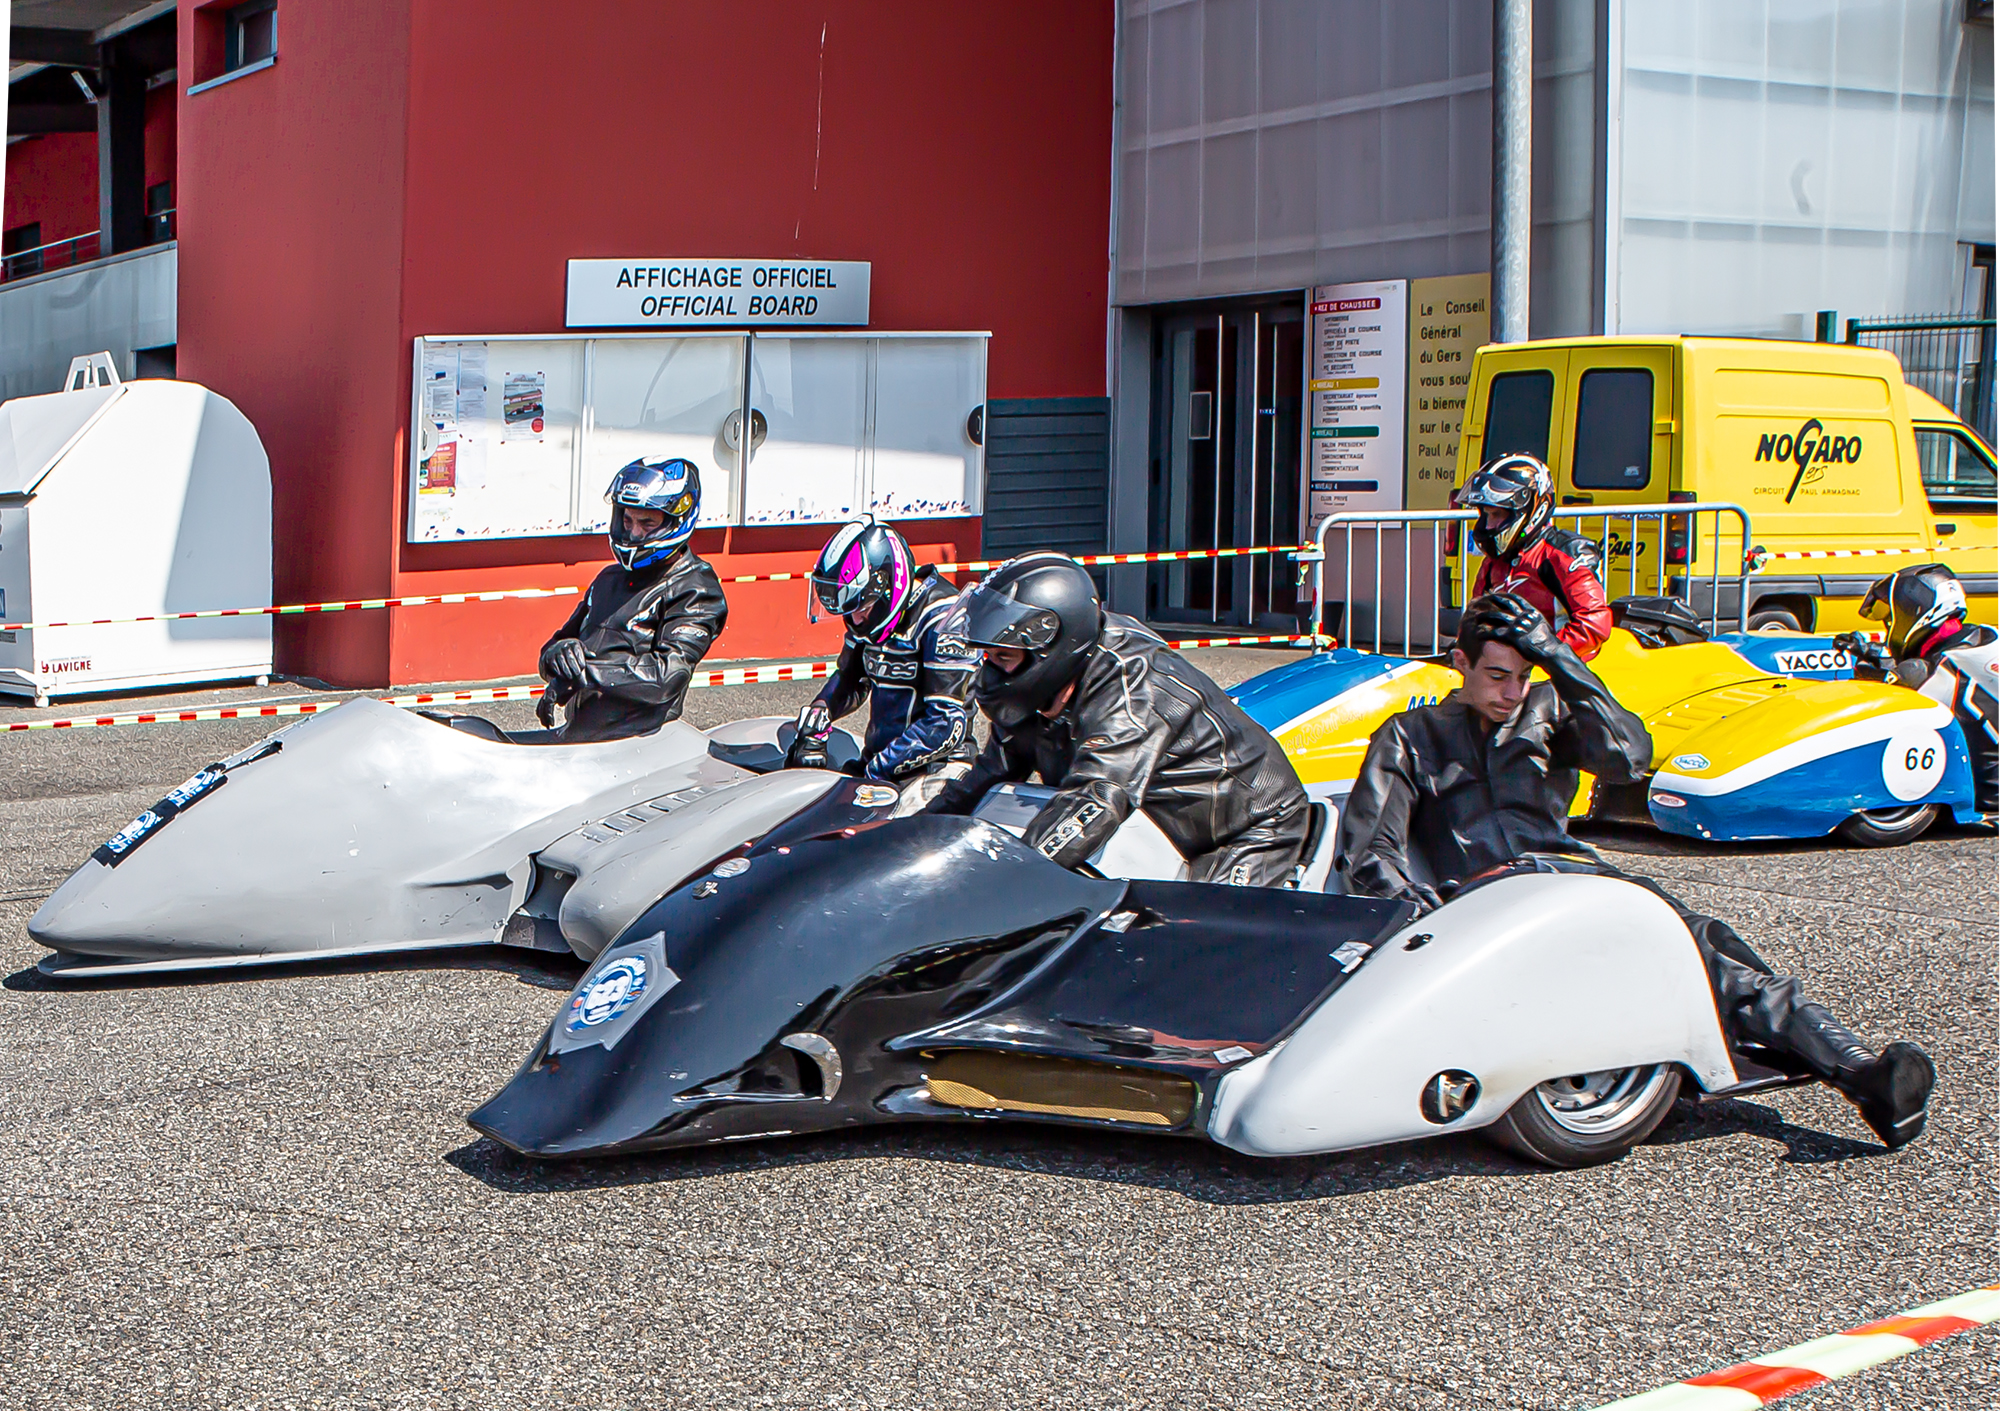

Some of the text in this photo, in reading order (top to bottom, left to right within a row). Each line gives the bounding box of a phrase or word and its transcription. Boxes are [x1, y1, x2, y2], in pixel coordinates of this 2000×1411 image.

[616, 267, 837, 289] AFFICHAGE OFFICIEL
[641, 295, 818, 317] OFFICIAL BOARD
[1330, 302, 1338, 311] DE
[1420, 298, 1485, 316] Le Conseil
[1420, 324, 1462, 340] Général
[1420, 349, 1462, 364] du Gers
[1420, 371, 1471, 387] vous sou
[1419, 396, 1467, 411] la bienve
[1419, 423, 1437, 434] sur
[1441, 420, 1451, 433] le
[1418, 443, 1459, 457] Paul Ar
[1754, 417, 1863, 505] NOGARO
[1418, 467, 1456, 483] de Nog
[1753, 487, 1861, 497] CIRCUIT PAUL ARMAGNAC
[52, 659, 92, 674] LAVIGNE
[1779, 652, 1848, 671] YACCO
[1904, 747, 1936, 771] 66
